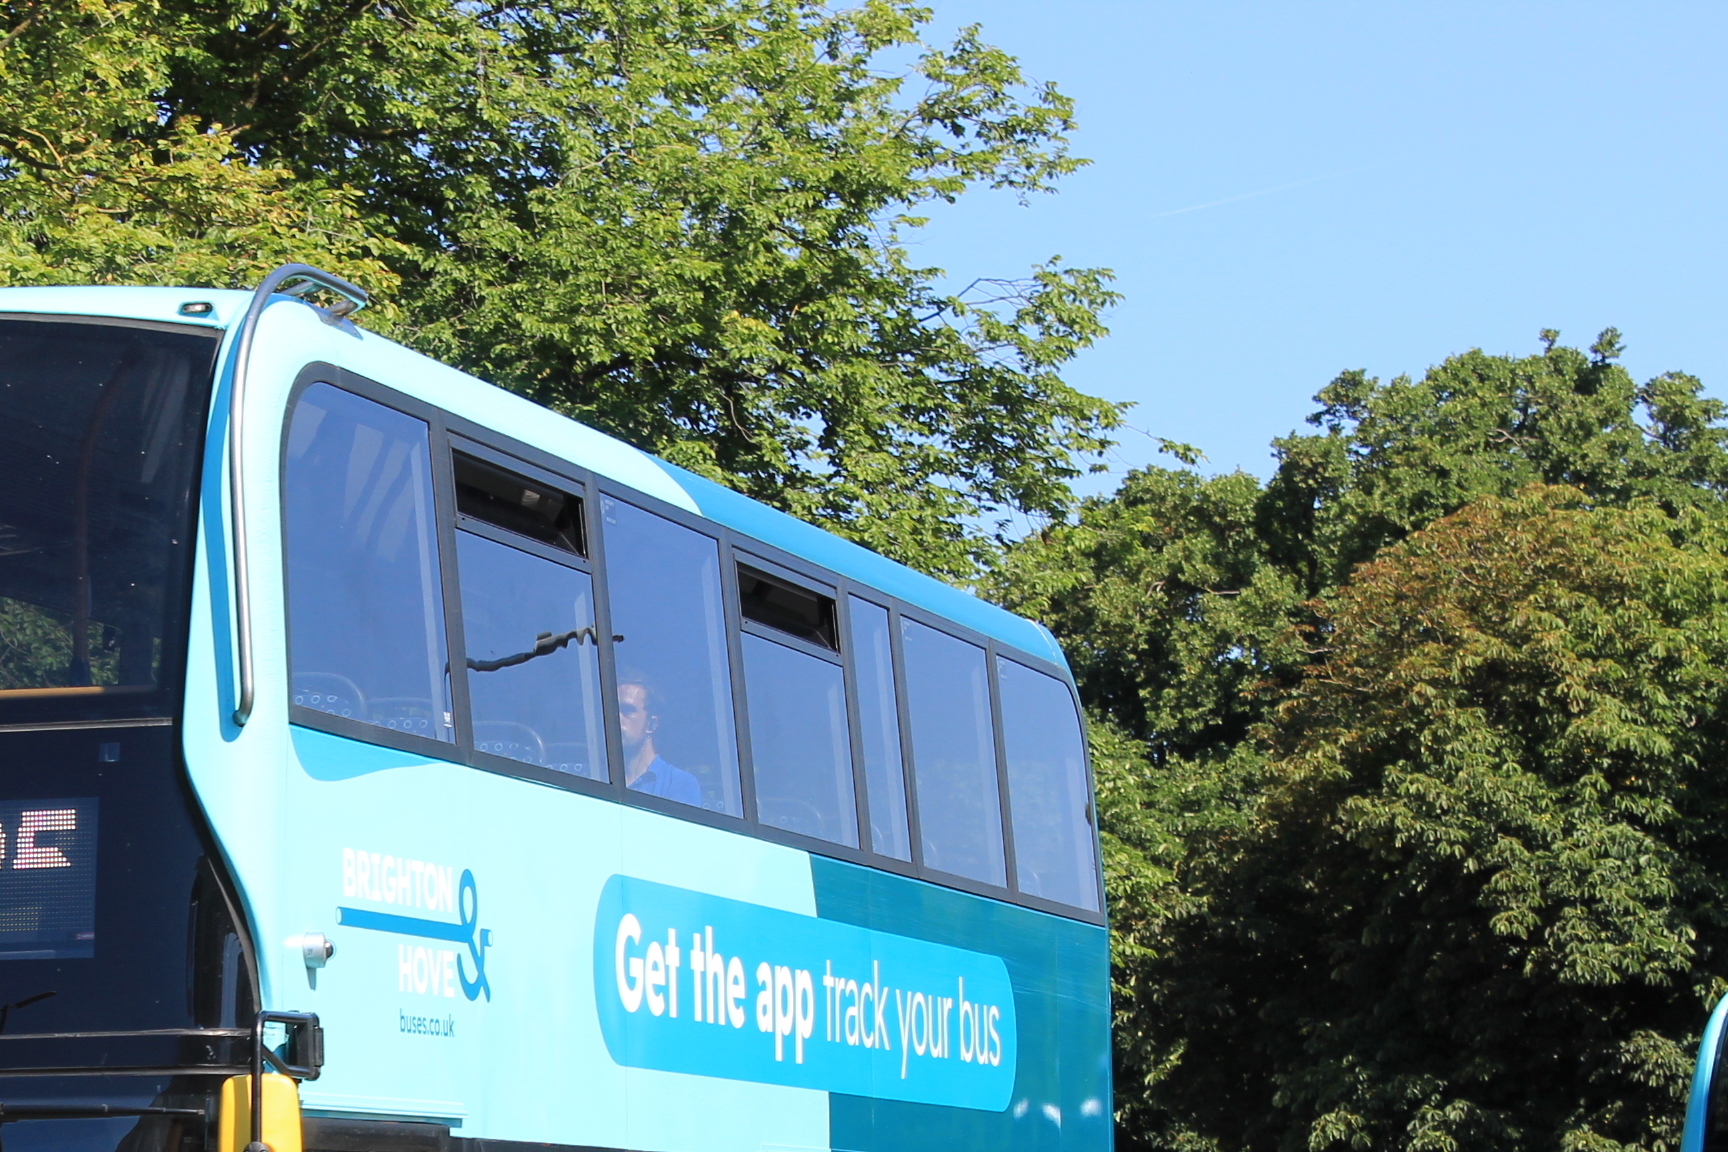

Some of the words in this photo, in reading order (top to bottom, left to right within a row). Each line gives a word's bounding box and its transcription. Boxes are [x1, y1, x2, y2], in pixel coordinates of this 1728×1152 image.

[342, 847, 453, 913] BRIGHTON
[398, 944, 456, 998] HOVE
[615, 913, 680, 1018] Get
[690, 925, 746, 1029] the
[756, 961, 814, 1064] app
[822, 959, 890, 1051] track
[895, 988, 953, 1080] your
[958, 976, 1001, 1067] bus
[399, 1008, 455, 1037] buses.co.uk
